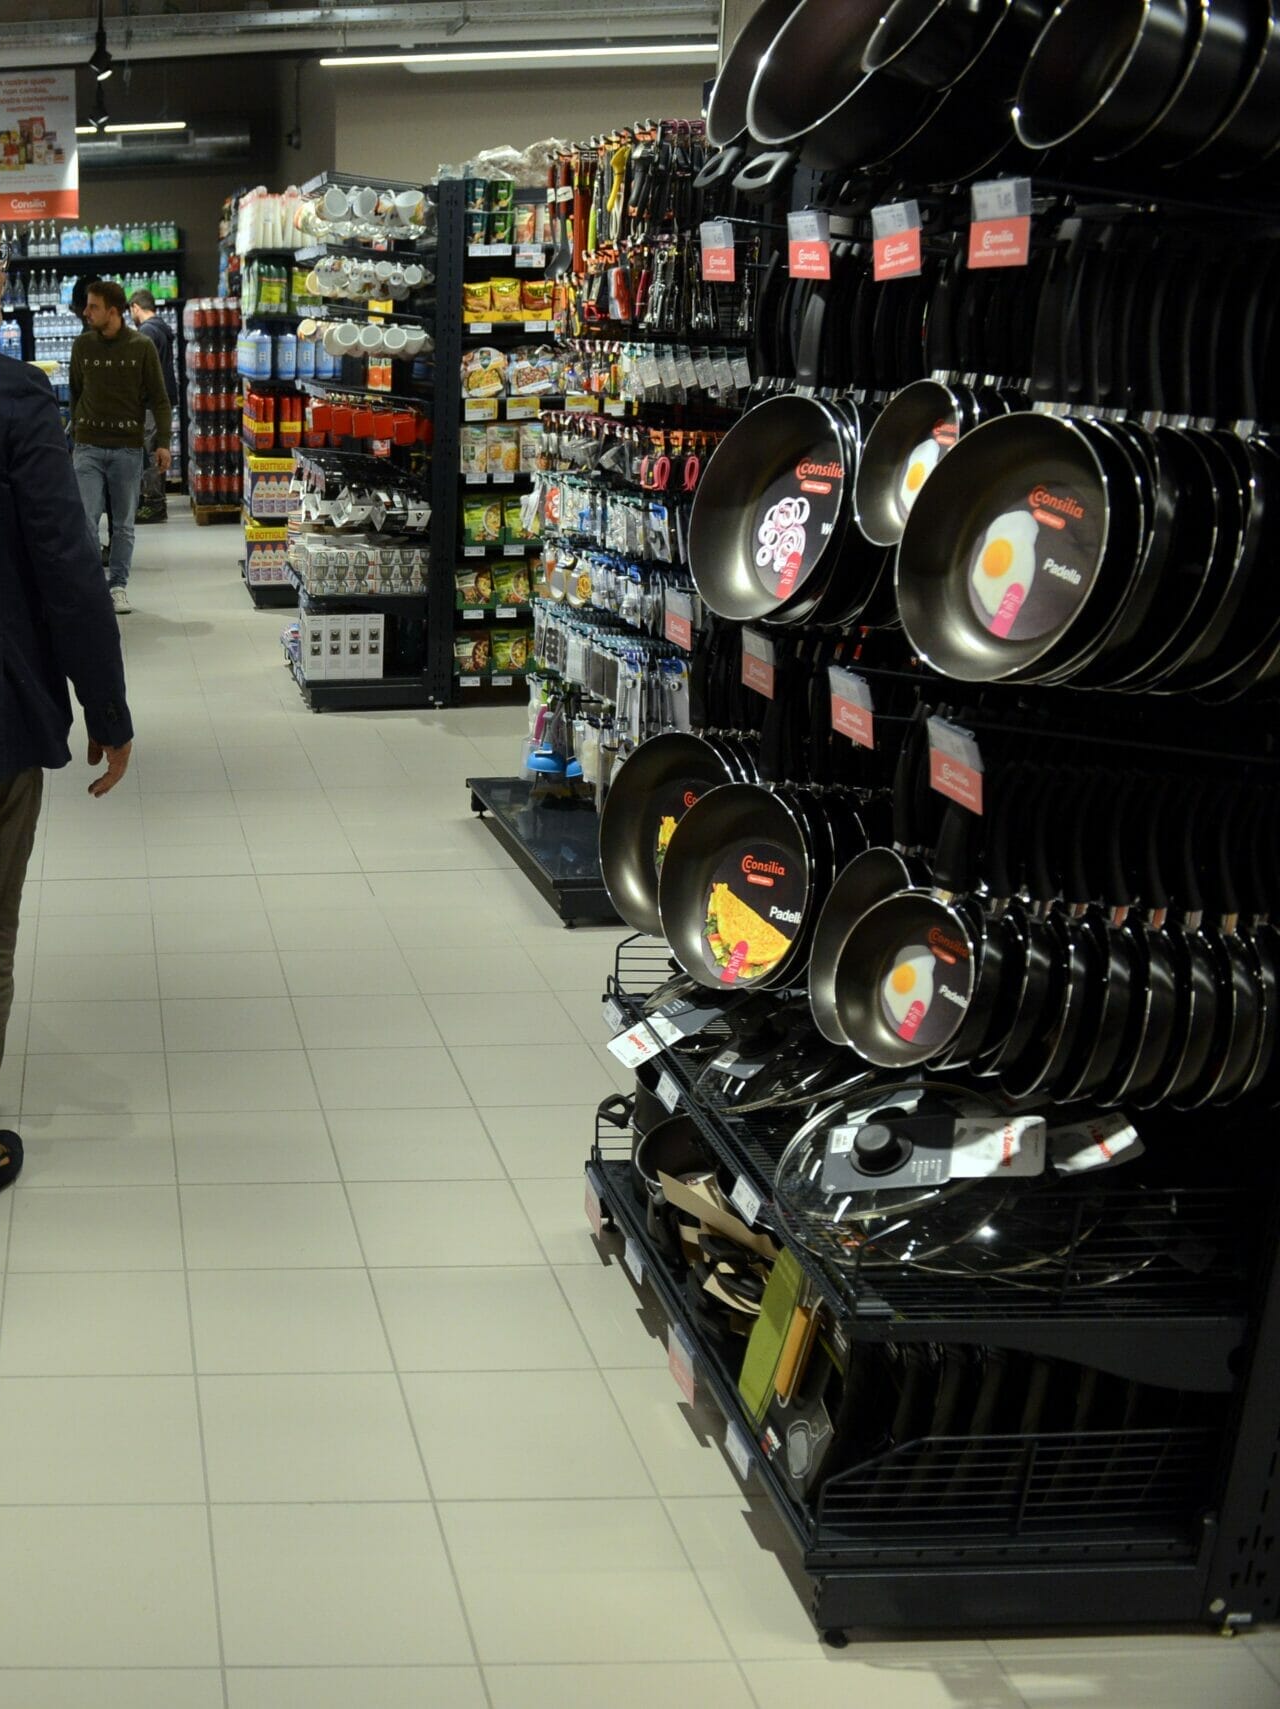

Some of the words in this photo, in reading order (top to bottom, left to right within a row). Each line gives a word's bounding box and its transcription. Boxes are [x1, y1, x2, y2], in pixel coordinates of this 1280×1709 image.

[10, 199, 46, 210] Consilia
[1028, 484, 1085, 520] Consilia
[1043, 557, 1081, 586] Padella
[742, 855, 785, 876] Consilia
